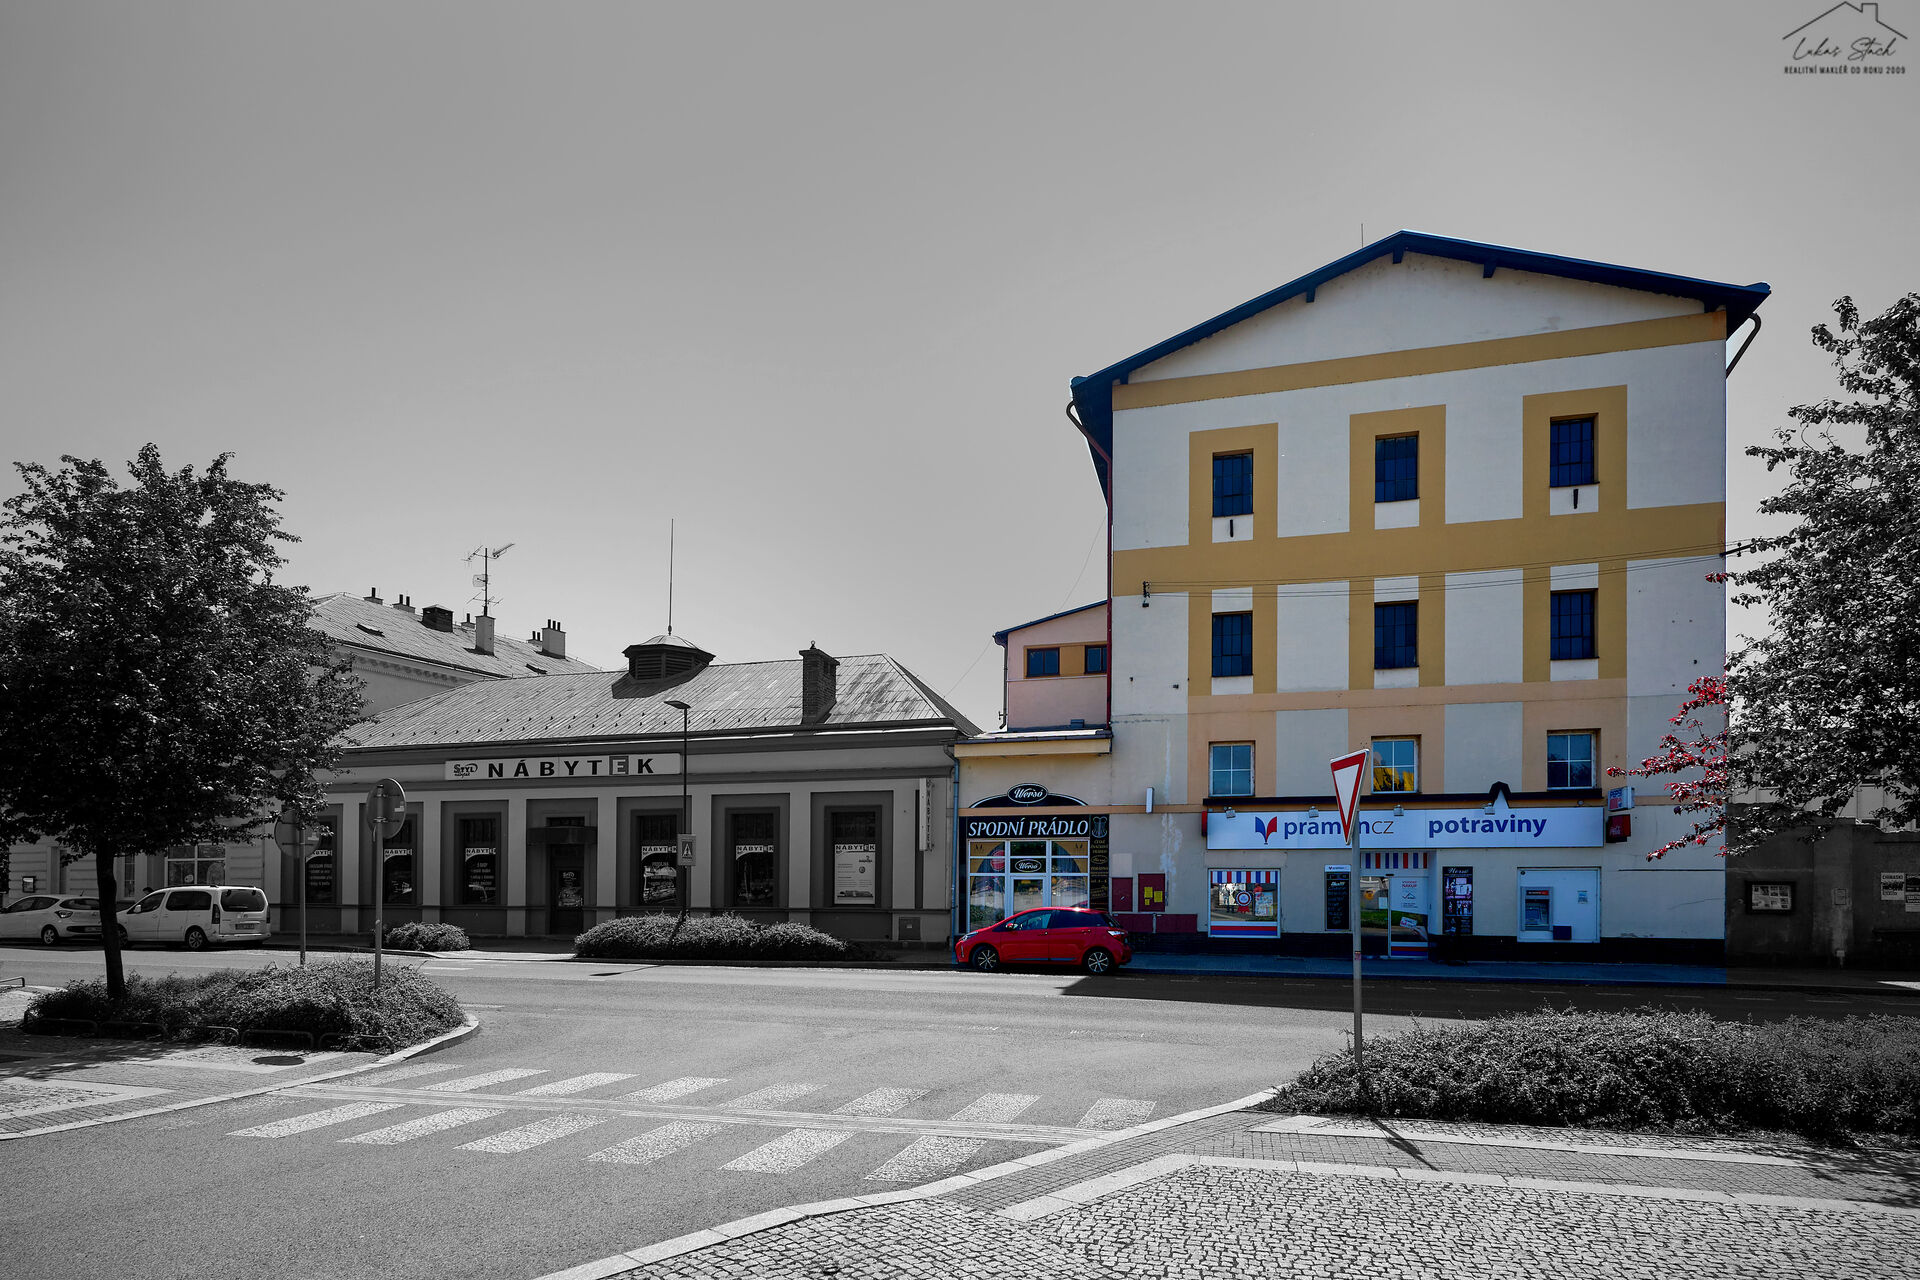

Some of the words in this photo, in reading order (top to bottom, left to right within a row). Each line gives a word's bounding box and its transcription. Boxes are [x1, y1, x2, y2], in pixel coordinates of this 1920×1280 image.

[488, 757, 654, 778] NÁBYTEK
[968, 818, 1026, 836] SPODNÍ
[1028, 817, 1089, 836] PRÁDLO
[1428, 814, 1547, 838] potraviny
